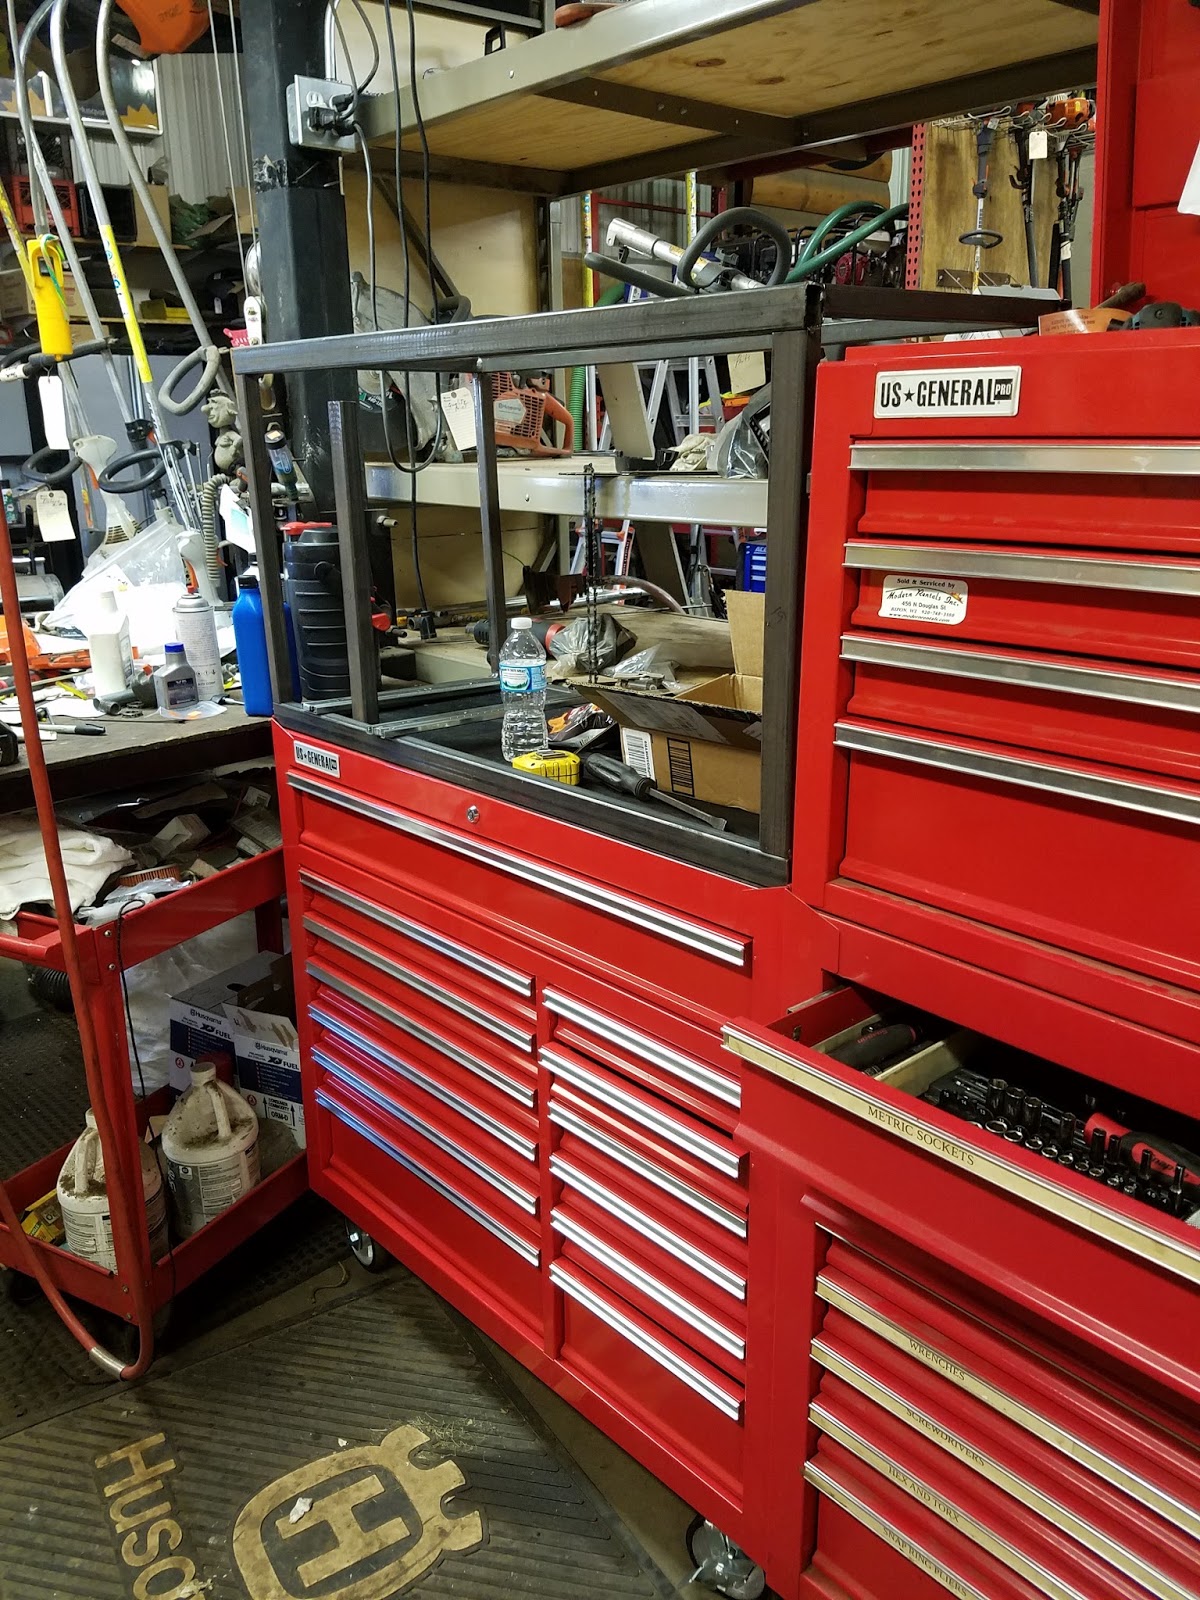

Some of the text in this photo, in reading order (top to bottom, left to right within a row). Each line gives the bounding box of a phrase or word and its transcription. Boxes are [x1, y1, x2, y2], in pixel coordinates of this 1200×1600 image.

[880, 378, 1012, 408] US GENERAL PRO
[887, 591, 913, 600] Modern
[919, 579, 946, 588] Serviced
[947, 581, 956, 589] by
[918, 602, 939, 610] Douglas
[295, 746, 304, 761] US
[307, 751, 333, 771] GENERAL
[215, 1029, 232, 1040] FUEL
[283, 1061, 300, 1071] FUEL
[867, 1105, 976, 1167] METRIC SOCKETS
[908, 1336, 966, 1381] WRENCHES
[906, 1406, 986, 1468] SCREWDRIVERS
[888, 1465, 962, 1523] HEX AND TORX
[882, 1526, 969, 1598] SNAP RING PLIERS
